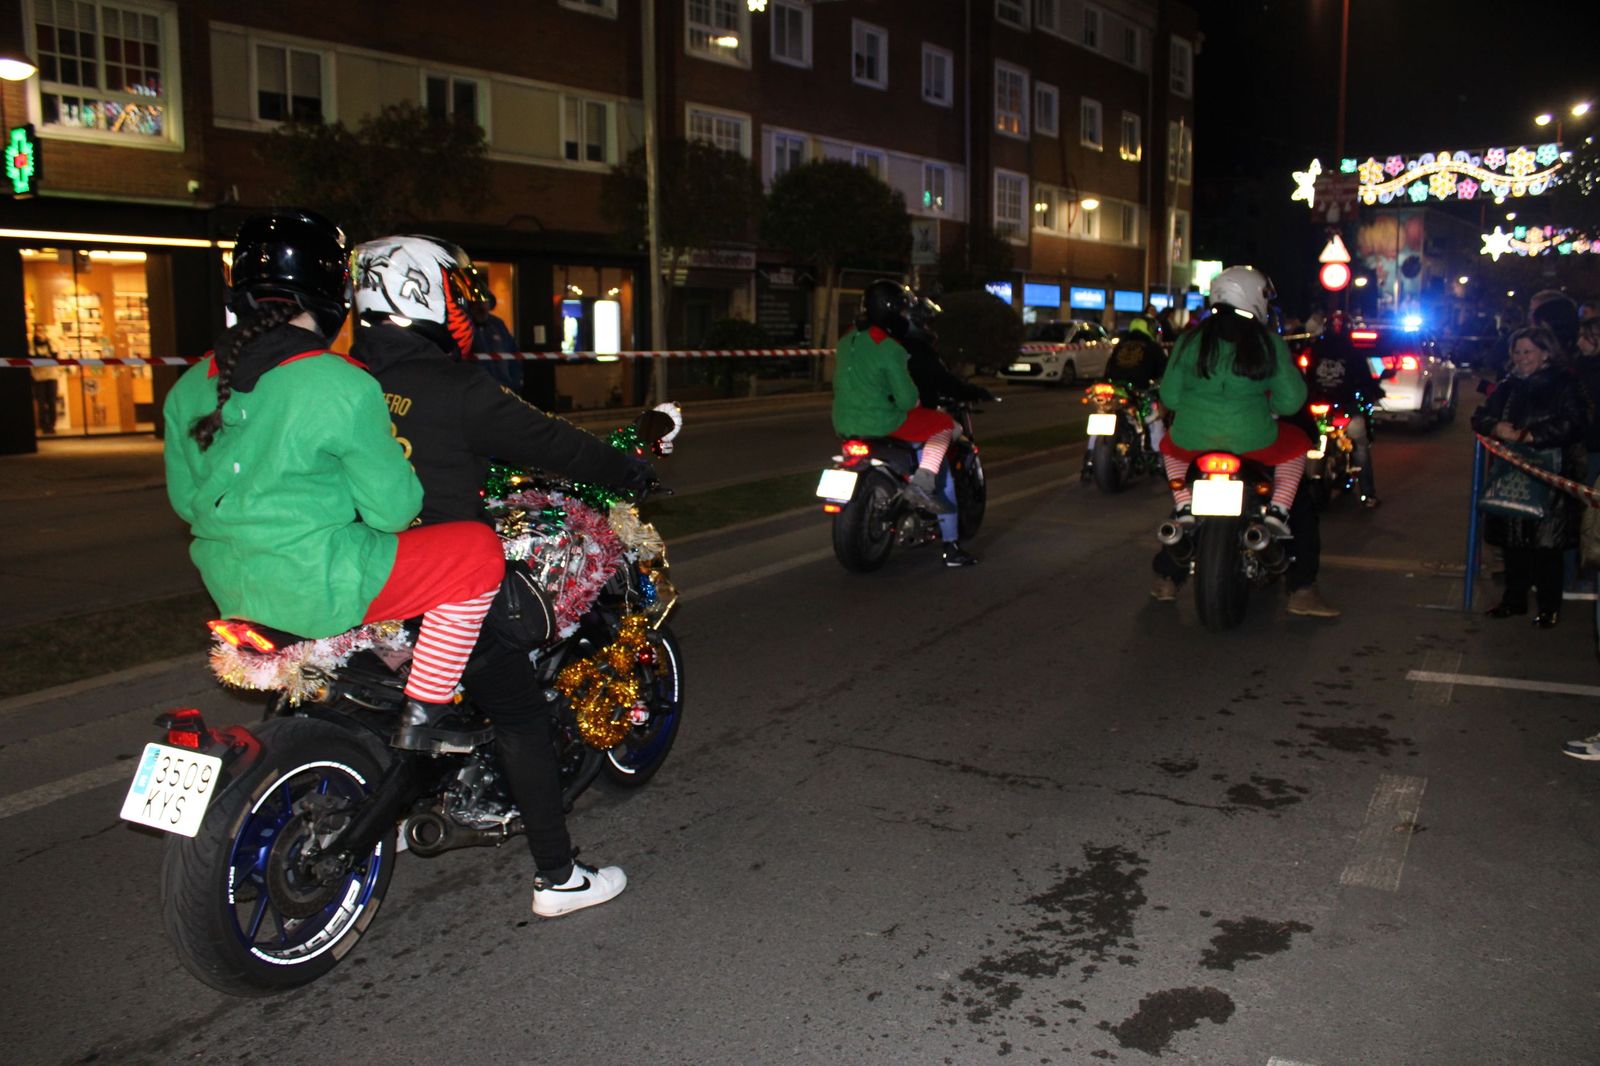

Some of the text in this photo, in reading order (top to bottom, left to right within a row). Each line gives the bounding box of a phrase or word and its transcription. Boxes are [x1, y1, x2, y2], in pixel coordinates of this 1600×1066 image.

[384, 392, 412, 416] ERO
[156, 756, 212, 793] 3509
[141, 788, 186, 824] KYS
